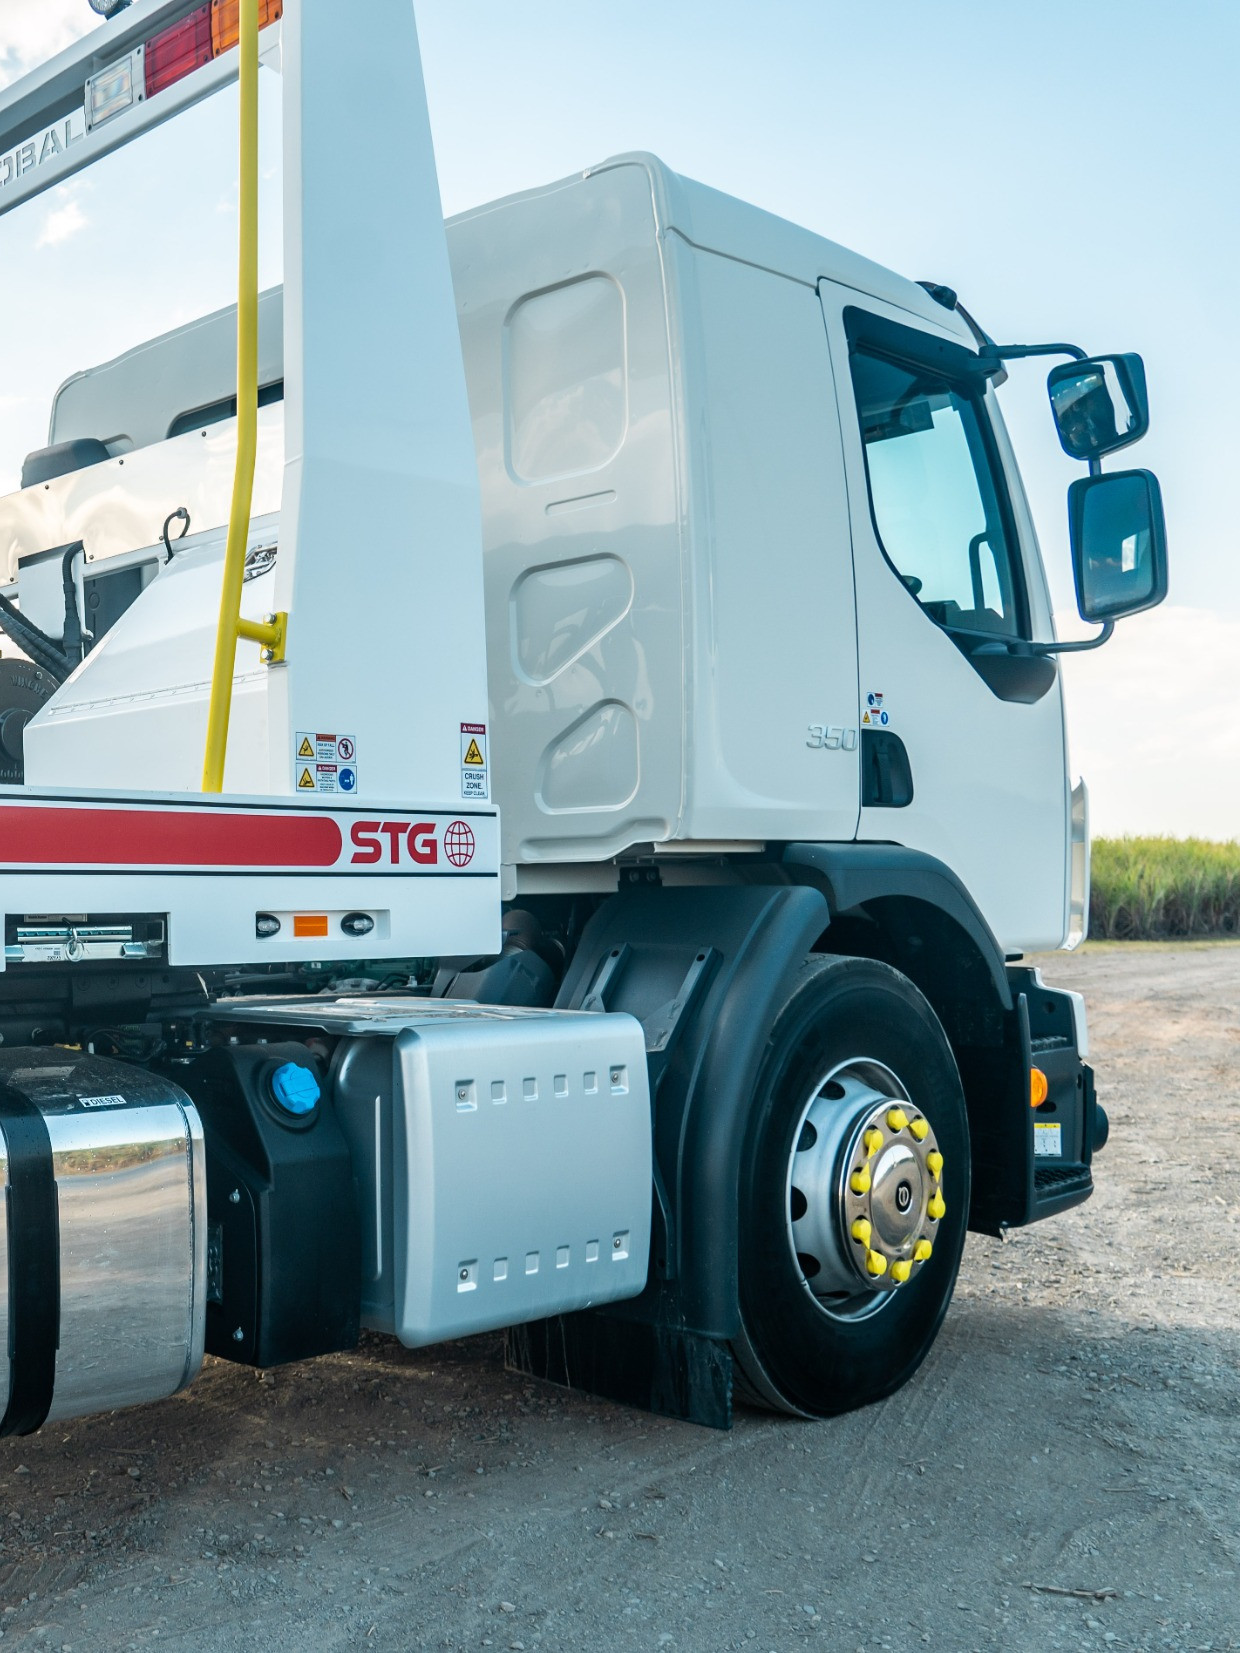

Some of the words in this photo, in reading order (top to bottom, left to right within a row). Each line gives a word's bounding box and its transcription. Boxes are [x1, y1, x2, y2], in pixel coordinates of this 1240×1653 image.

[806, 724, 858, 752] 350
[464, 772, 485, 780] CRUSH
[350, 820, 438, 864] STG
[90, 1096, 124, 1105] DIESEL
